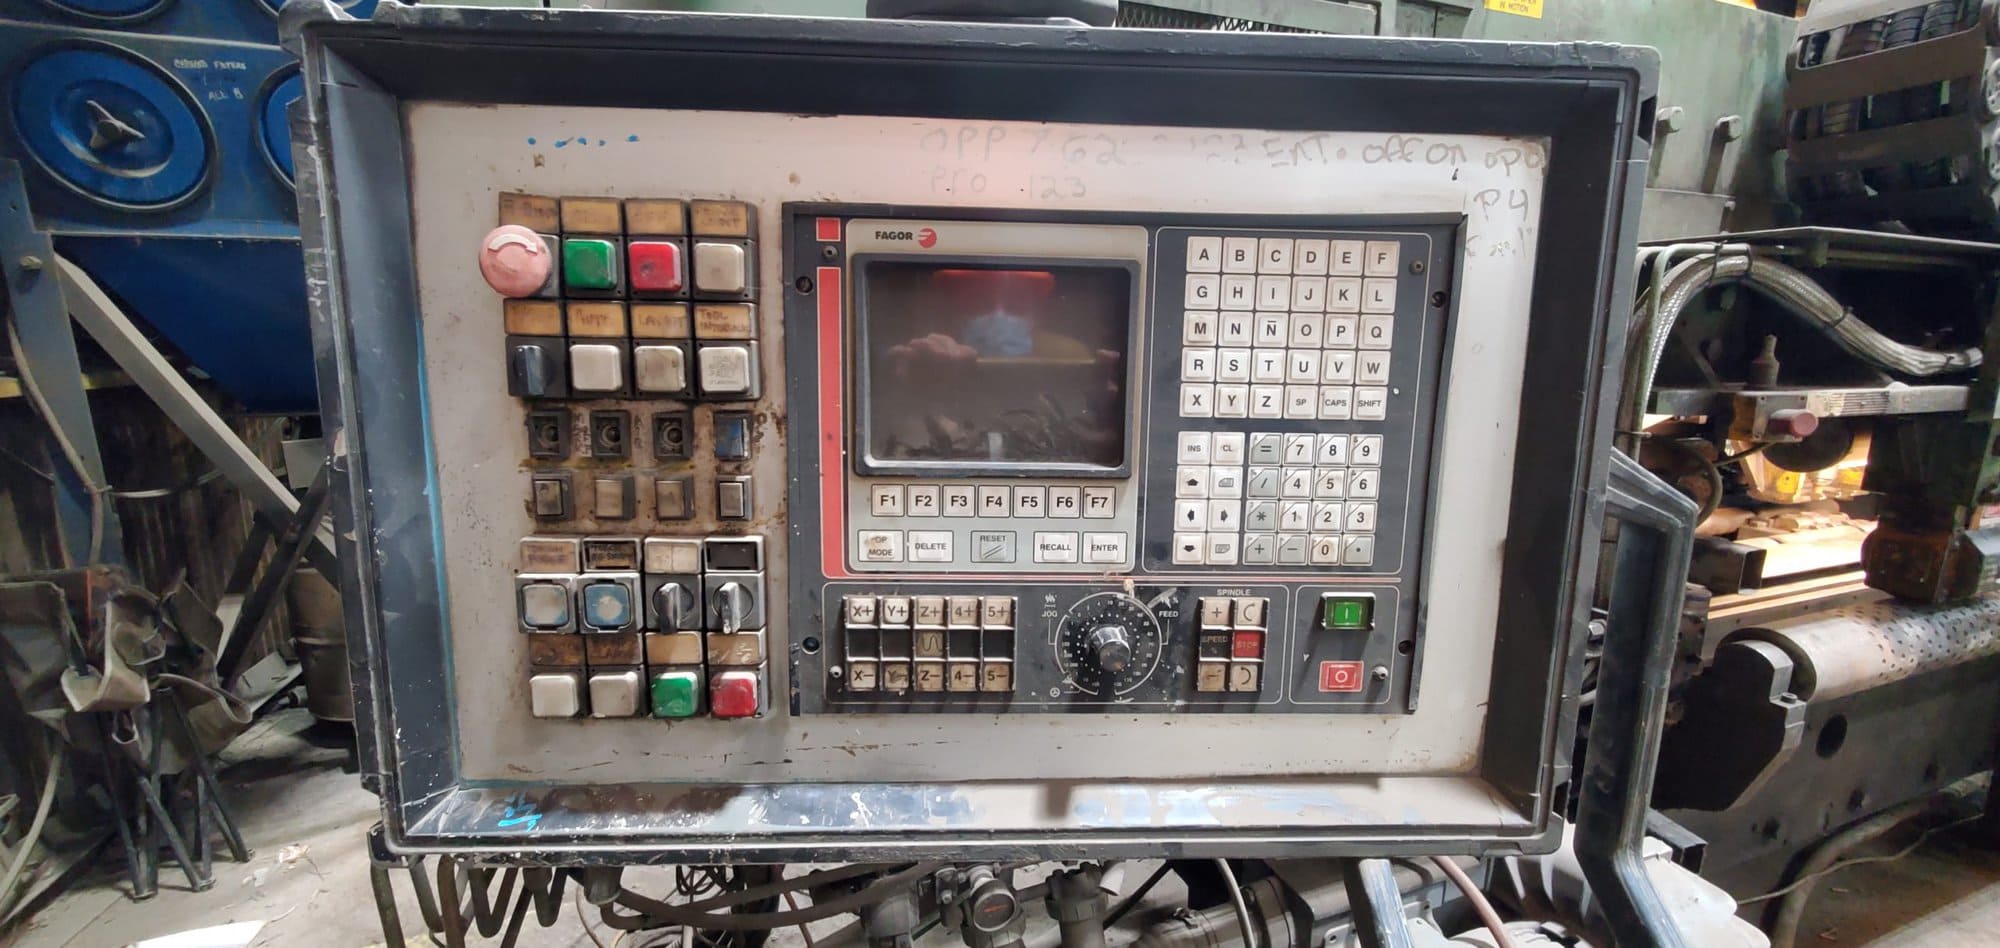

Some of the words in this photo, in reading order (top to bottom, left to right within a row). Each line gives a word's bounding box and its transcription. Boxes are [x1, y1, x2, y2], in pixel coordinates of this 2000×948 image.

[874, 230, 914, 242] FAGOR
[1198, 248, 1210, 261] A
[1234, 249, 1245, 262] B
[1270, 249, 1281, 263] C
[1305, 250, 1317, 264] D
[1341, 251, 1352, 264] E
[1377, 252, 1387, 265] F
[1196, 285, 1208, 299] G
[1232, 286, 1244, 299] H
[1271, 287, 1275, 300] I
[1304, 287, 1313, 301] J
[1338, 288, 1349, 301] K
[1374, 289, 1383, 302] L
[1194, 322, 1207, 335] M
[1230, 322, 1241, 335] N
[1300, 323, 1312, 337] O
[1336, 325, 1346, 338] P
[1370, 325, 1382, 339] Q
[1193, 358, 1204, 371] R
[1229, 359, 1239, 372] S
[1264, 359, 1274, 372] T
[1298, 360, 1309, 374] U
[1334, 361, 1344, 374] V
[1366, 362, 1381, 375] W
[1191, 394, 1202, 407] X
[1227, 394, 1237, 407] Y
[1261, 395, 1272, 408] Z
[1295, 398, 1307, 406] SP
[1324, 399, 1347, 407] CAPS
[1357, 400, 1382, 408] SHIFT
[1187, 444, 1202, 453] INS
[1222, 444, 1233, 453] CL
[1295, 444, 1305, 456] 7
[1328, 444, 1337, 457] 8
[1362, 445, 1371, 457] 9
[1293, 477, 1301, 490] 4
[1326, 478, 1335, 490] 5
[1359, 478, 1368, 490] 6
[880, 494, 896, 507] F1
[915, 494, 932, 507] F2
[950, 495, 968, 507] F3
[985, 495, 1003, 508] F4
[1021, 495, 1038, 508] F5
[1056, 496, 1074, 509] F6
[1091, 496, 1109, 509] F7
[1291, 510, 1297, 523] 1
[1323, 511, 1332, 523] 2
[1356, 511, 1365, 524] 3
[979, 534, 1007, 543] RESET
[869, 548, 893, 557] MODE
[914, 542, 947, 551] DELETE
[1039, 543, 1072, 552] RECALL
[1091, 543, 1119, 552] ENTER
[1321, 544, 1330, 556] 0
[1216, 588, 1252, 597] SPINDLE
[852, 605, 873, 617] X+
[887, 605, 908, 617] Y+
[920, 605, 941, 618] Z+
[954, 605, 975, 617] 4+
[987, 605, 1009, 617] 5+
[1041, 610, 1058, 618] JOG
[1158, 610, 1179, 618] FEED
[1237, 641, 1257, 649] STOP
